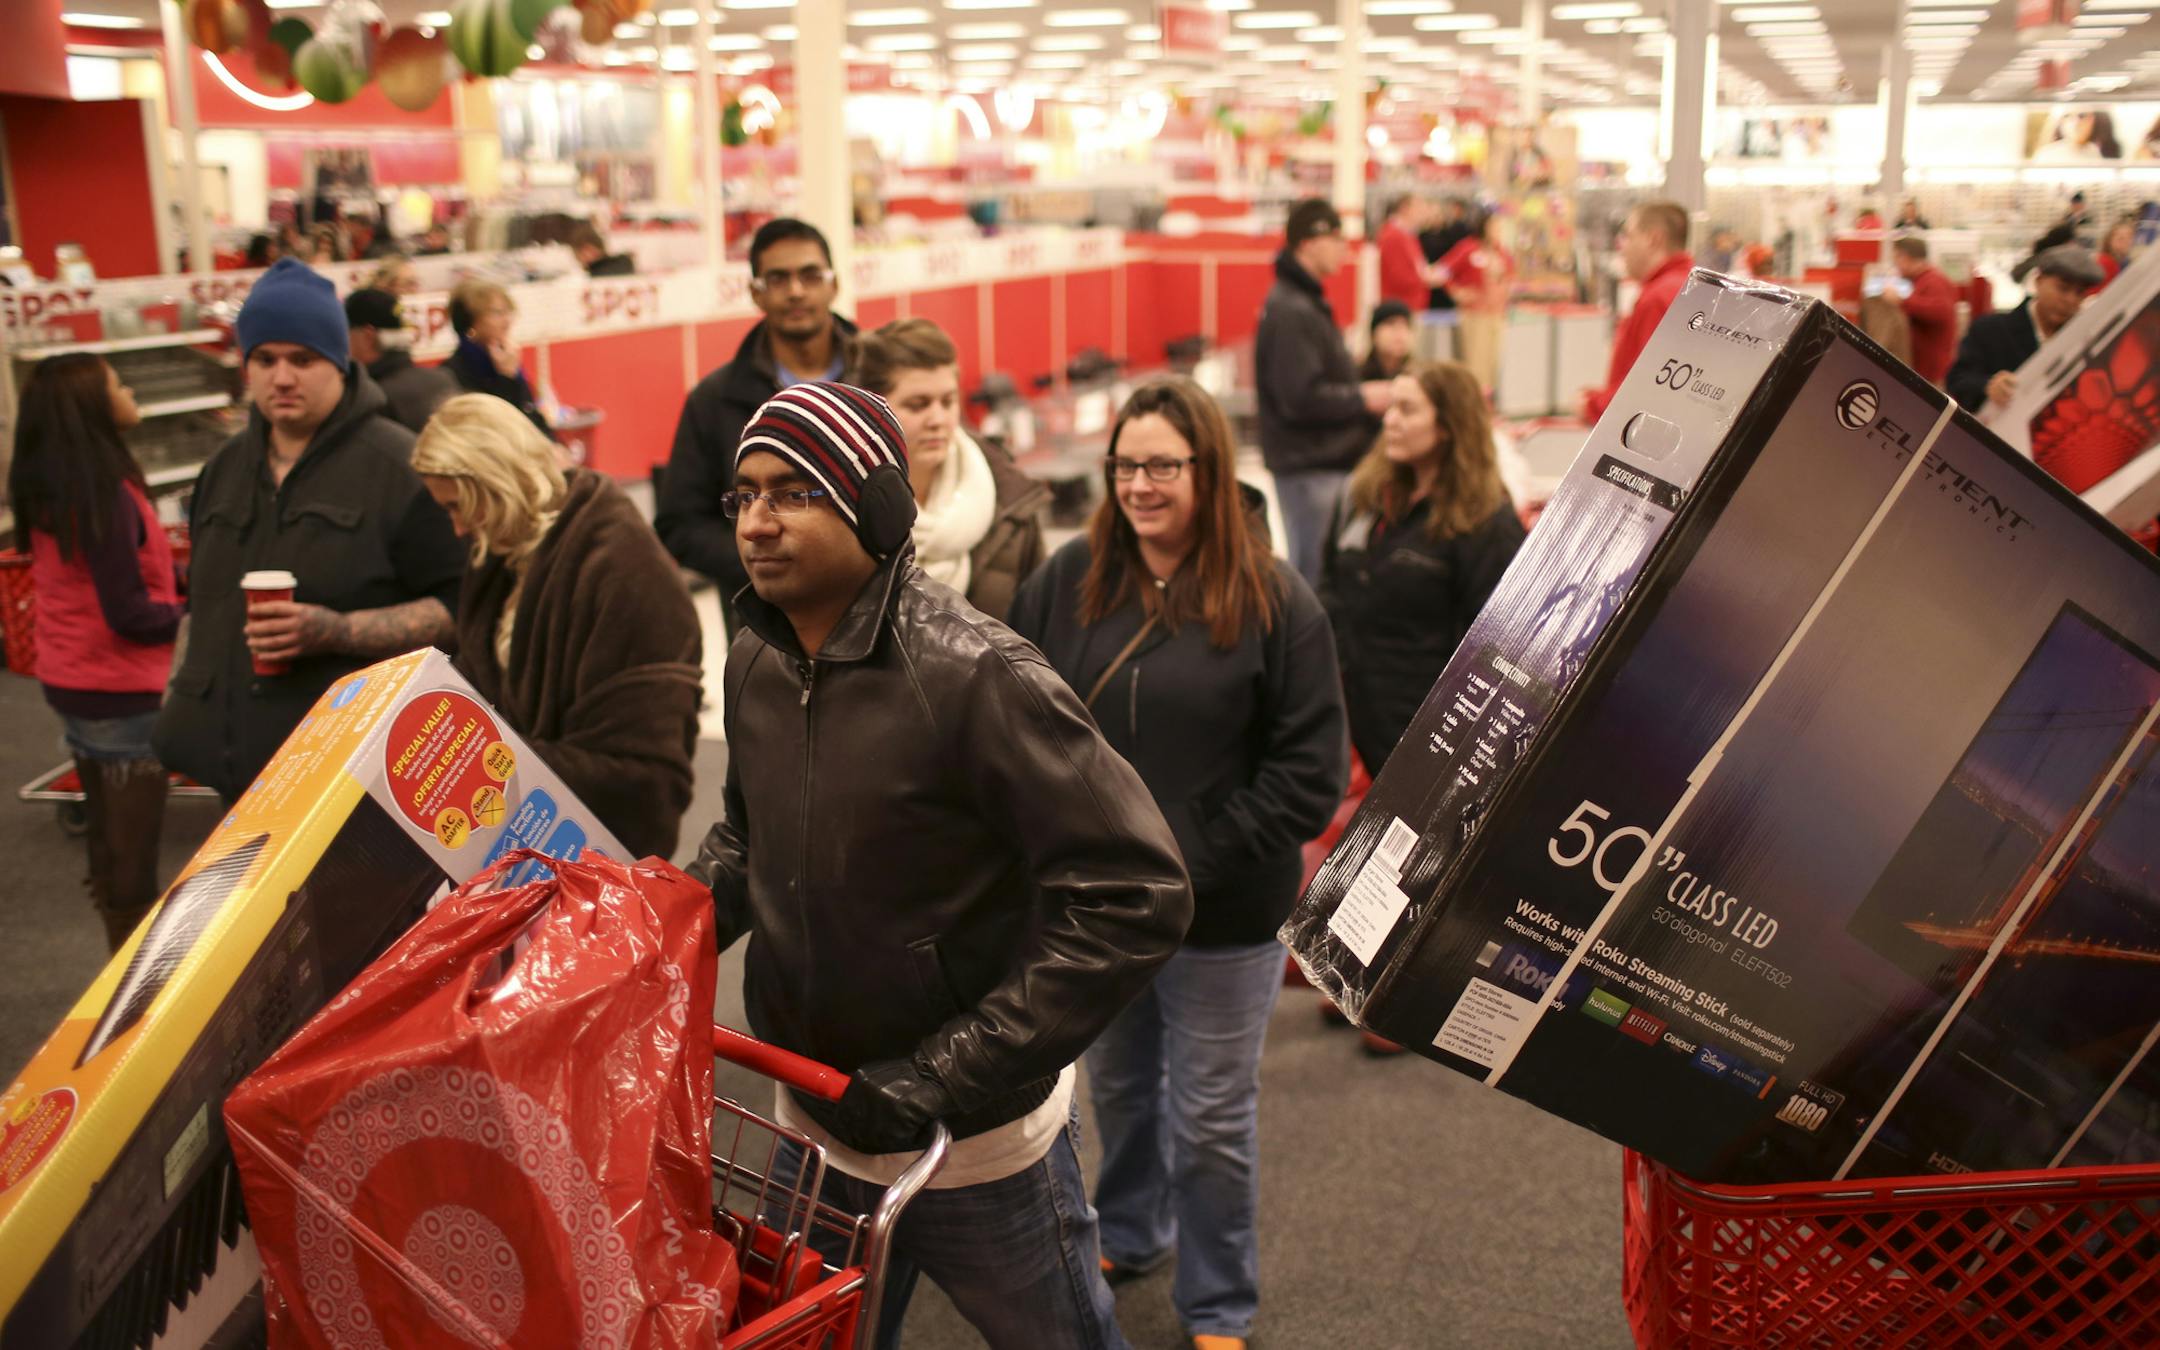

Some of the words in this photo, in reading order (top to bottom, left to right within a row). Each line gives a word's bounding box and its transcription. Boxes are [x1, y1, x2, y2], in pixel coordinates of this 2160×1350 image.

[583, 285, 658, 323] SPOT
[1702, 320, 1761, 344] ELEMENT
[1690, 379, 1711, 396] CLASS
[1709, 386, 1725, 400] LED
[1606, 464, 1654, 495] SPECIFICATIONS
[1873, 416, 2030, 529] ELEMENT
[1865, 432, 2017, 543] ELETRONICS
[1491, 655, 1531, 688] CONNECTIVITY
[1504, 699, 1525, 718] Composite
[390, 732, 426, 777] SPECIAL
[421, 697, 451, 735] VALUE!
[402, 756, 422, 780] Includes
[418, 740, 434, 758] Stand,
[430, 732, 440, 742] AC
[436, 711, 455, 735] Adapter
[413, 767, 424, 780] and
[421, 752, 435, 769] Quick
[432, 739, 445, 753] Start
[441, 723, 456, 741] Guide
[410, 763, 444, 808] ¡OFERTA
[440, 717, 477, 765] ESPECIAL!
[417, 795, 435, 816] Incluye
[463, 725, 487, 753] adaptador
[462, 752, 476, 768] inicio
[486, 747, 502, 766] Quick
[493, 754, 507, 771] Start
[499, 758, 514, 778] Guide
[472, 788, 490, 811] Stand
[539, 807, 549, 819] de
[509, 800, 535, 831] Sampling
[444, 817, 465, 845] ADAPTER
[1666, 871, 1738, 926] CLASS
[1730, 906, 1780, 949] LED
[1513, 898, 1562, 932] Works
[1559, 921, 1588, 944] wit
[1590, 939, 1630, 968] Roku
[1626, 956, 1698, 1006] Streaming
[1694, 990, 1730, 1017] Stick
[1728, 1014, 1752, 1030] (sold
[1749, 1024, 1796, 1053] separately)
[1729, 947, 1793, 989] ELEFT502
[1472, 981, 1488, 992] Target
[1487, 988, 1502, 998] Stores
[1503, 915, 1544, 944] Requires
[1542, 935, 1594, 968] high-sed
[1591, 960, 1628, 985] Internet
[1626, 977, 1646, 993] and
[1644, 986, 1672, 1007] Wi-Fi.
[1670, 1000, 1693, 1017] Visit:
[1690, 1011, 1786, 1065] roku.com/streamingstick
[1626, 1011, 1660, 1037] NETFLIX
[1662, 1030, 1697, 1054] CRACKLE
[1698, 1048, 1729, 1074] Disney
[1732, 1068, 1761, 1086] PANDORA
[1798, 1080, 1821, 1097] FULL
[1820, 1091, 1836, 1104] HD
[1781, 1094, 1828, 1131] 1080
